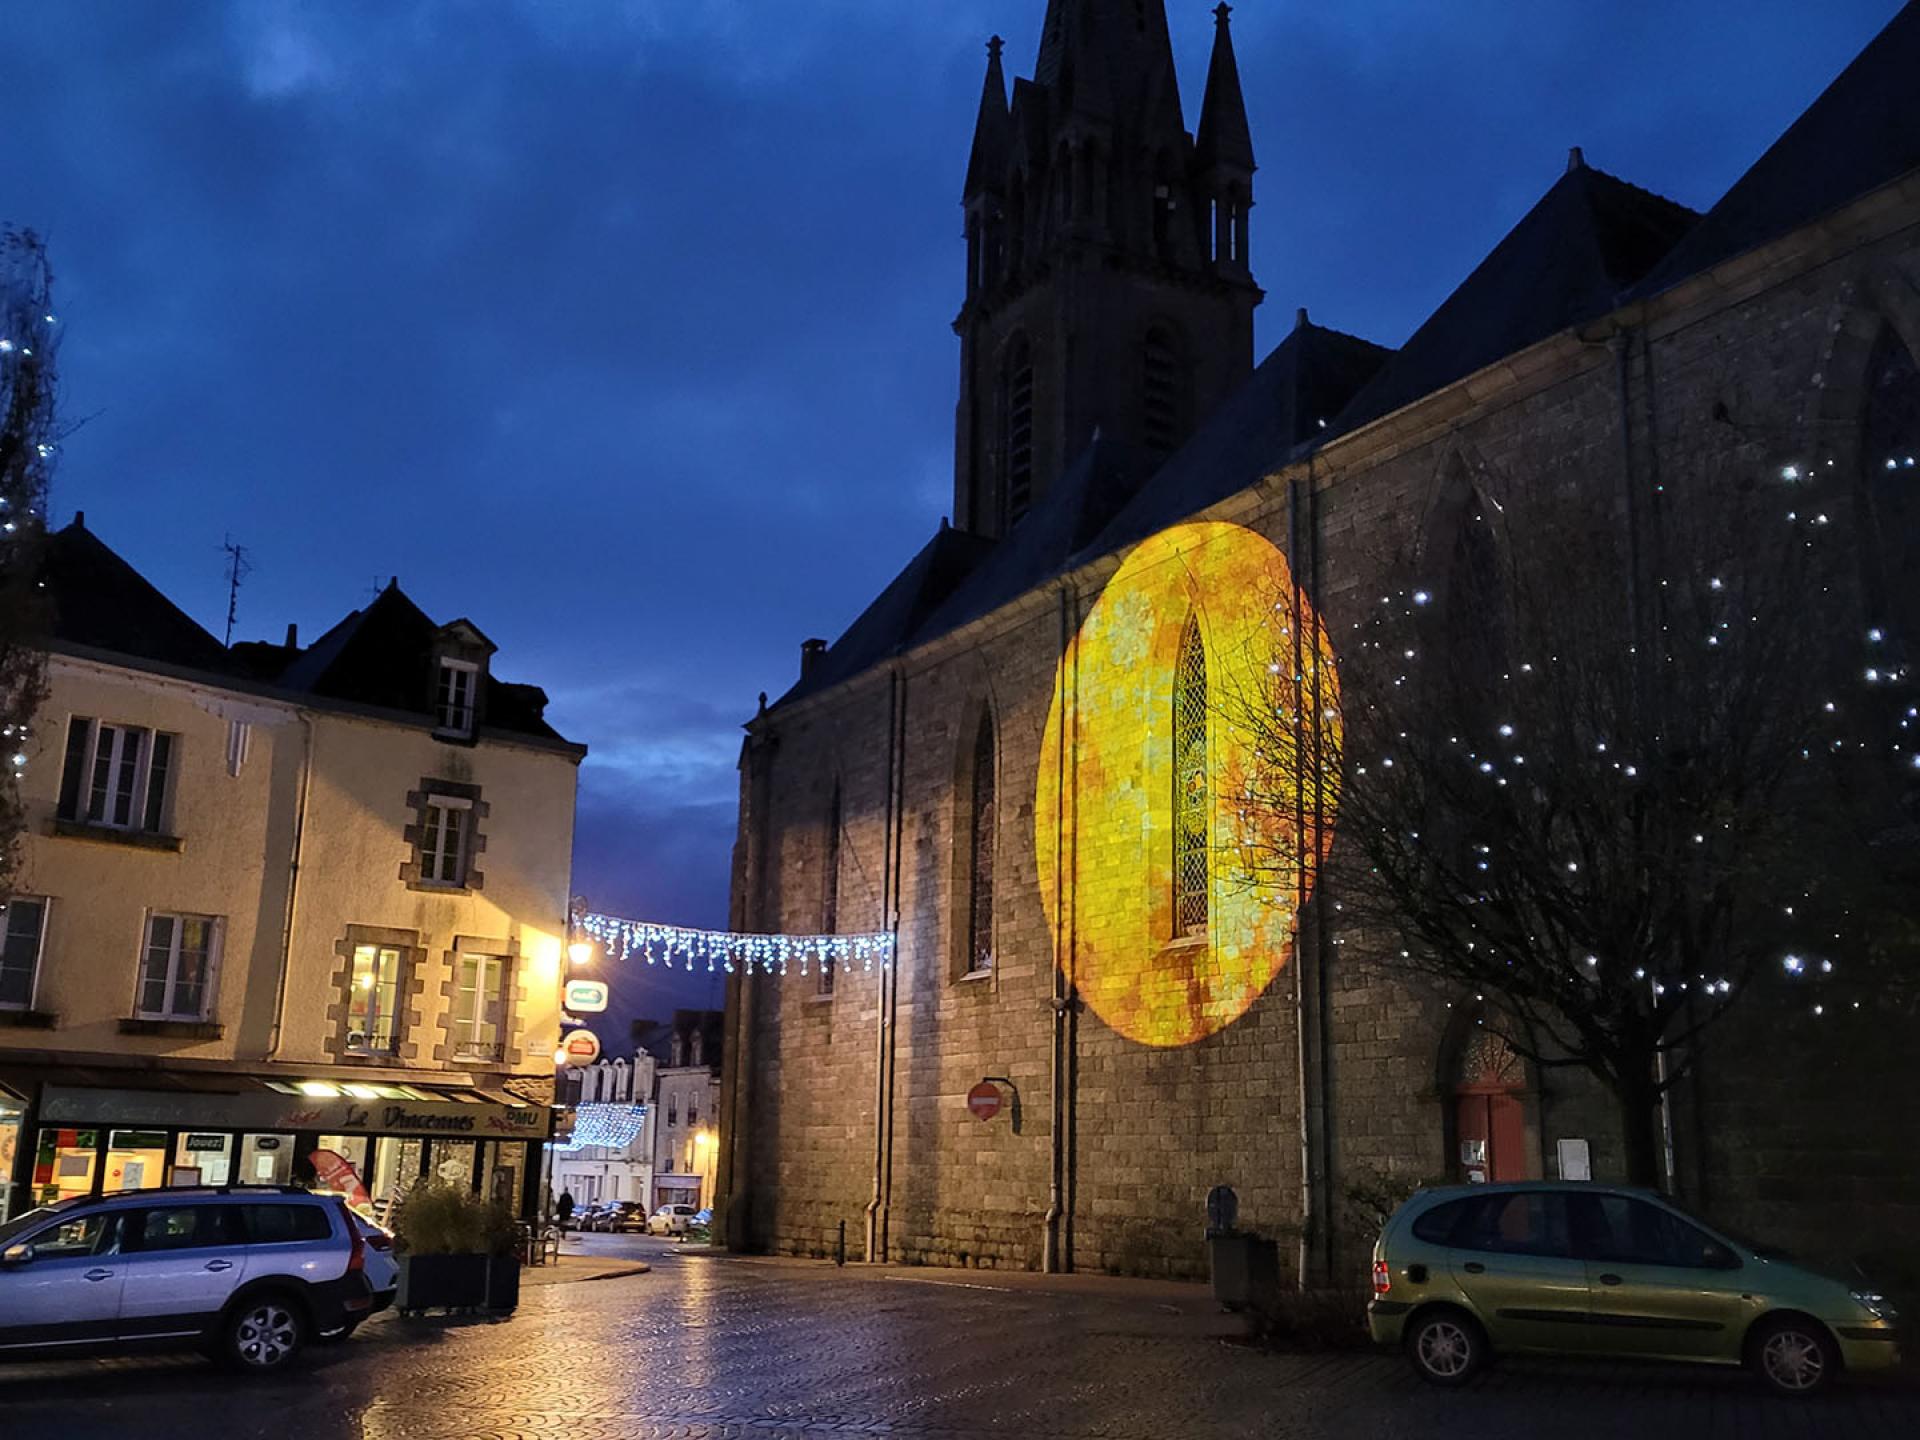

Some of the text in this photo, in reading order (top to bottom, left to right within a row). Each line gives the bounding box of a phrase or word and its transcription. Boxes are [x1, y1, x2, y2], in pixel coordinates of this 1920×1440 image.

[342, 1104, 476, 1131] Le Vincennes
[506, 1111, 539, 1126] PMU
